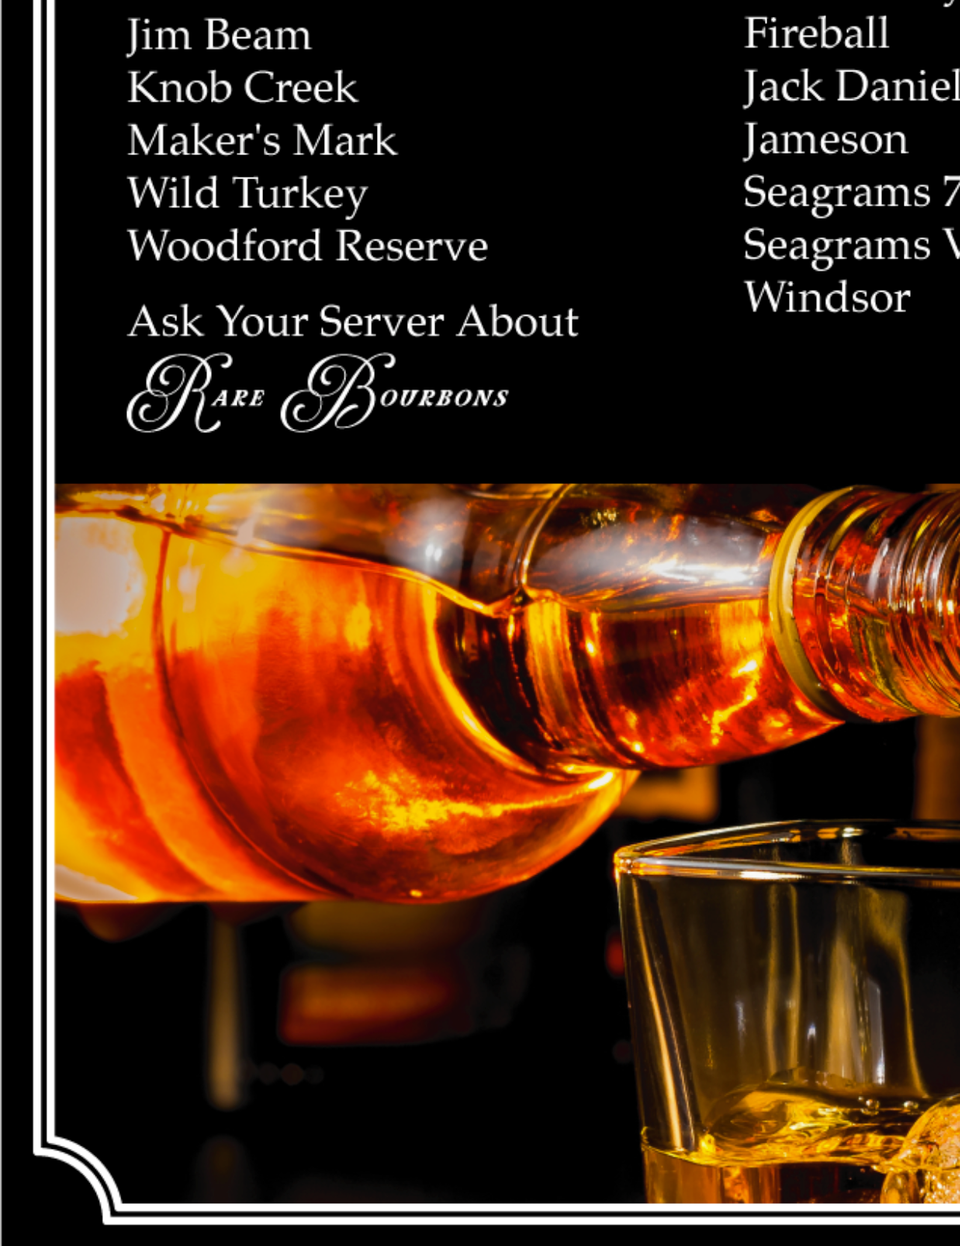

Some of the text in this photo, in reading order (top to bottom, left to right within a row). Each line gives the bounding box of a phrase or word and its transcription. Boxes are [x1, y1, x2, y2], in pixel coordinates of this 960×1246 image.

[125, 17, 313, 59] Jim Beam
[744, 14, 890, 49] Fireball
[127, 69, 360, 104] Knob Creek
[742, 67, 826, 110] Jack
[127, 122, 399, 156] Maker's Mark
[742, 121, 910, 163] Jameson
[126, 174, 369, 221] Wild Turkey
[743, 173, 931, 220] Seagrams
[126, 227, 489, 262] Woodford Reserve
[743, 226, 931, 272] Seagrams
[743, 279, 912, 313] Windsor
[126, 303, 580, 338] Ask Your Server About
[126, 352, 510, 434] RARE BOURBONS
